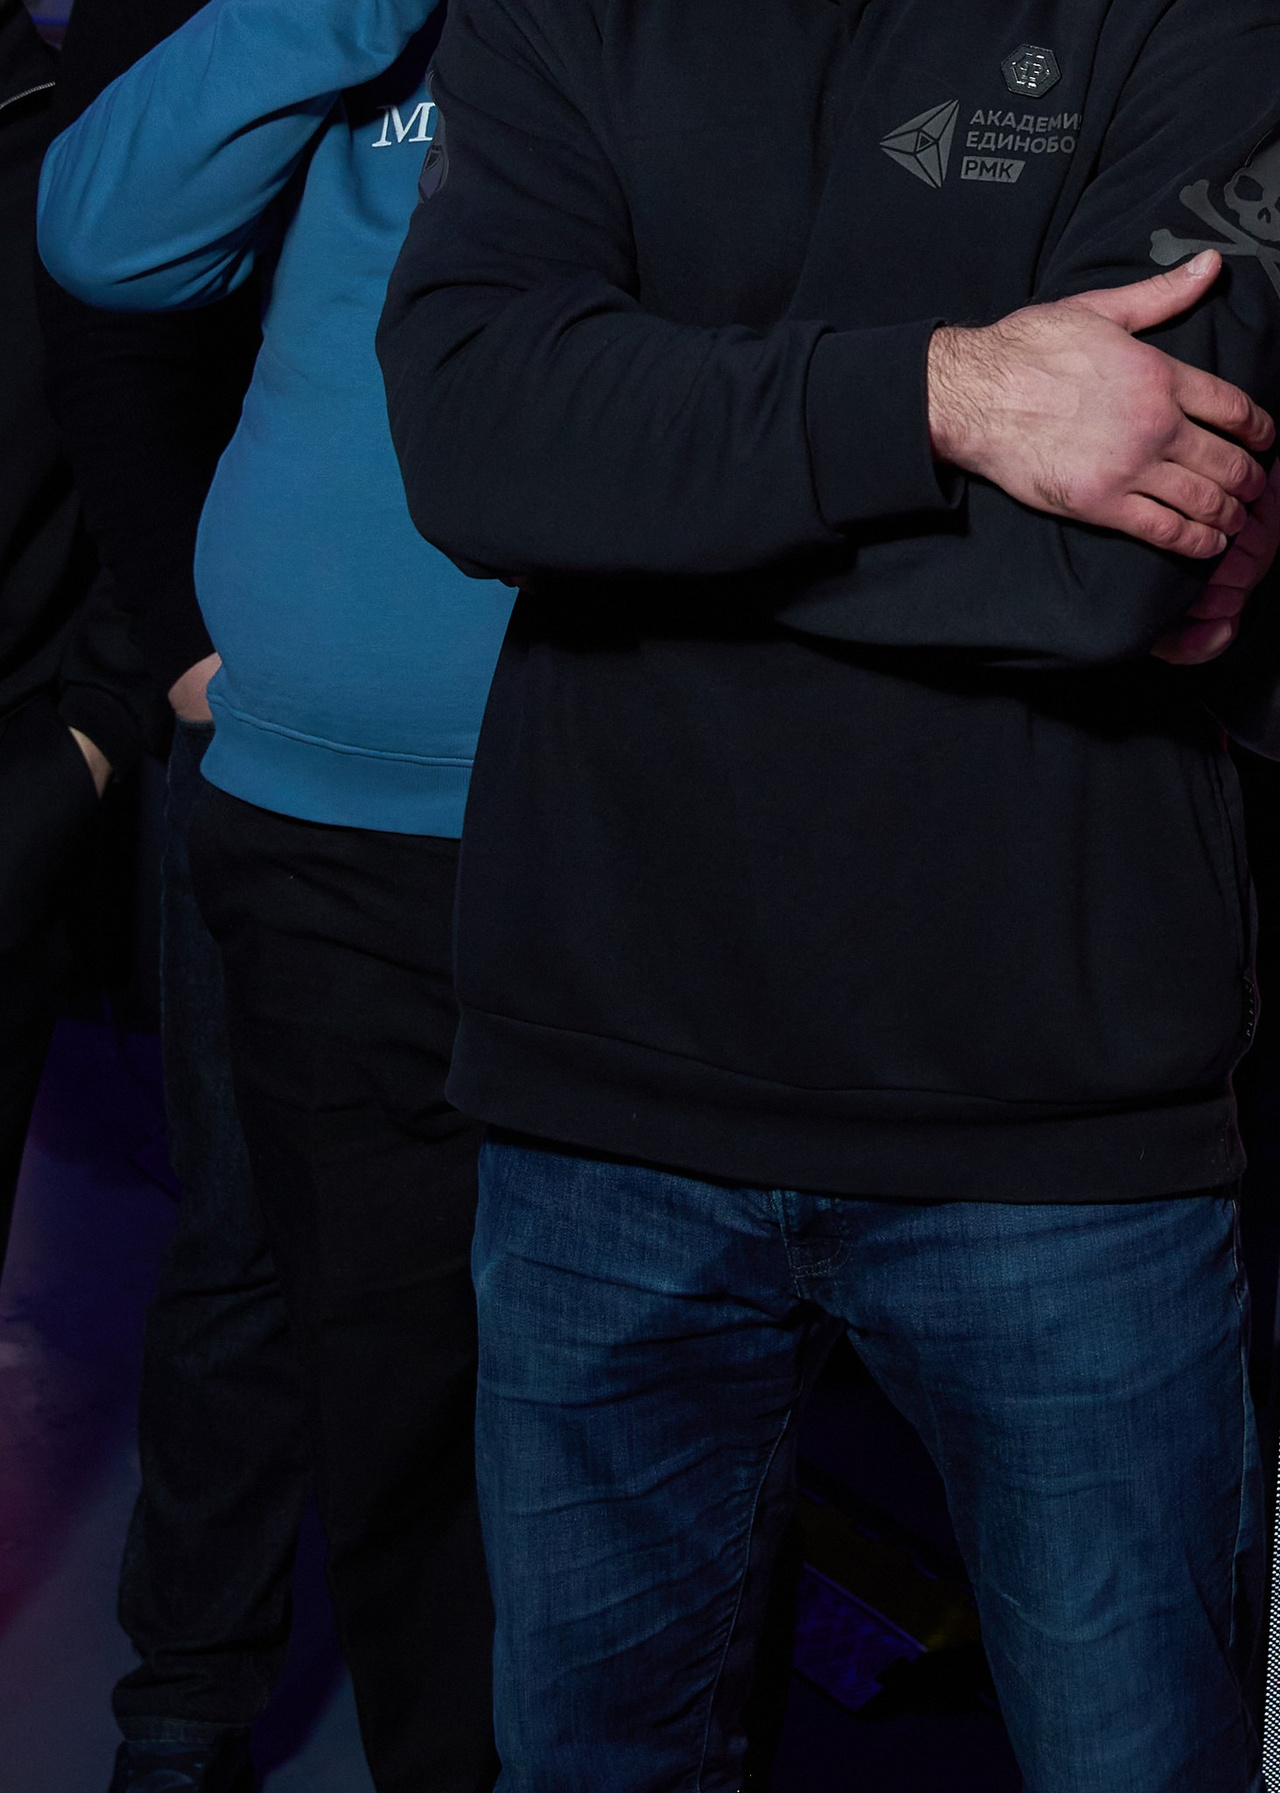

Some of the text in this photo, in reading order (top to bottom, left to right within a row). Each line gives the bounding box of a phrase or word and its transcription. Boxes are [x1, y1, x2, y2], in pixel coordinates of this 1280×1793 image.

[372, 102, 436, 147] M
[969, 109, 1082, 135] АКАДЕМИ
[964, 159, 1014, 179] РМК
